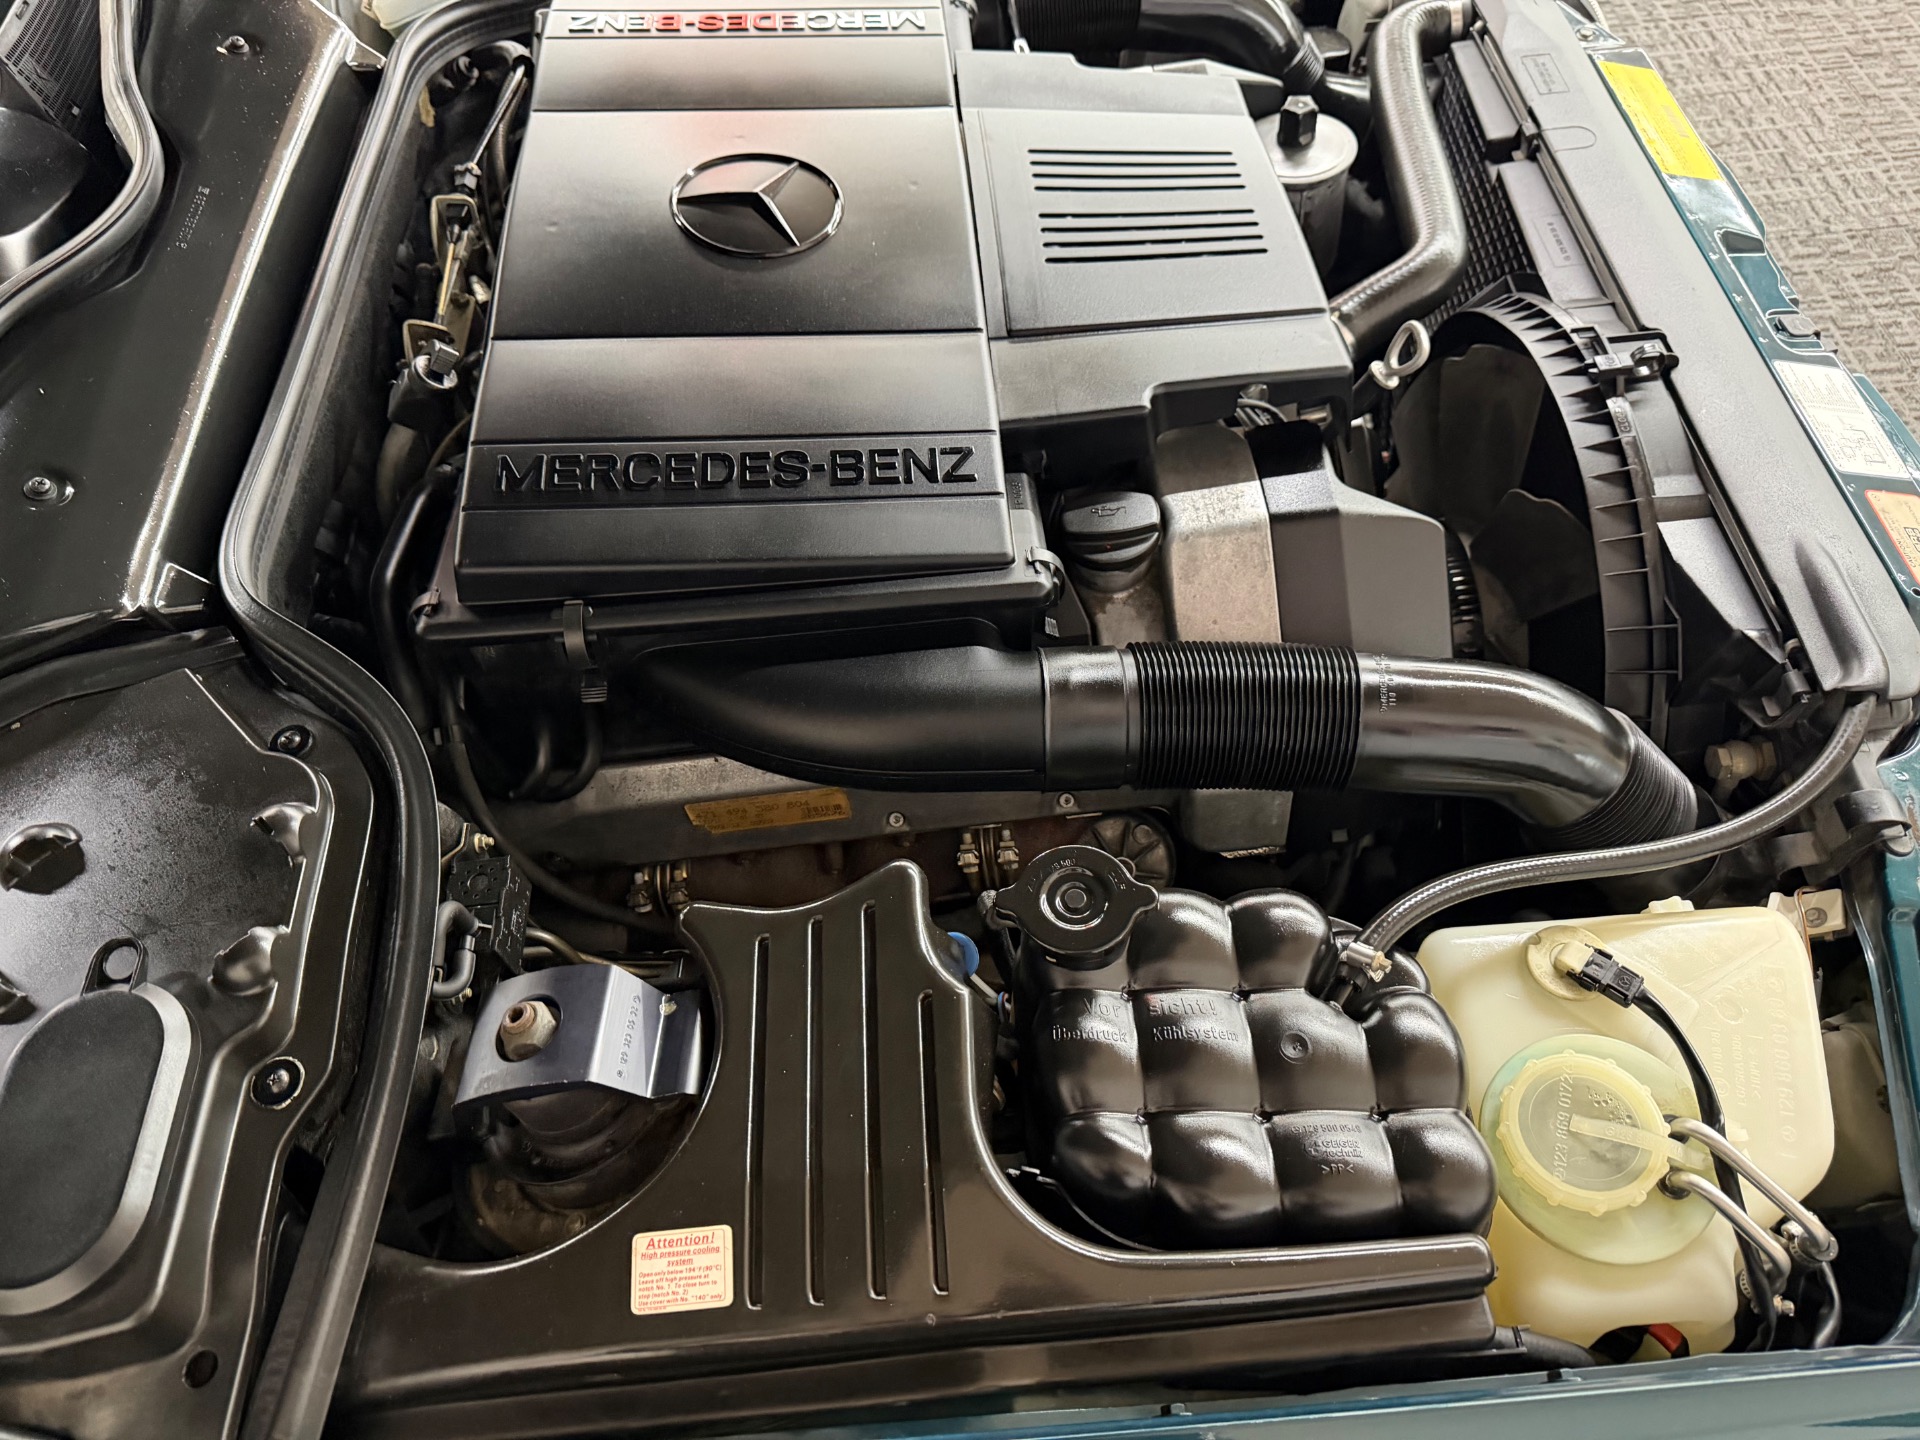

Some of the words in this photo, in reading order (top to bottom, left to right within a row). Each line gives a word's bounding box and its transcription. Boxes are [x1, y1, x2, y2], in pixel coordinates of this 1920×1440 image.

[567, 11, 926, 33] MERCEDES-BENZ
[494, 446, 979, 493] MERCEDES-BENZ
[1083, 998, 1121, 1017] Vor
[1149, 998, 1218, 1017] sicht!
[1052, 1025, 1129, 1043] Überdruck
[1152, 1025, 1239, 1042] Kühlsystem
[1322, 1139, 1360, 1149] GEIGER
[646, 1232, 714, 1249] Attention!
[640, 1251, 658, 1260] High
[660, 1249, 691, 1259] pressure
[693, 1245, 720, 1256] cooling
[667, 1258, 693, 1267] system
[638, 1271, 654, 1279] Open
[667, 1268, 684, 1276] below
[679, 1274, 702, 1282] pressure
